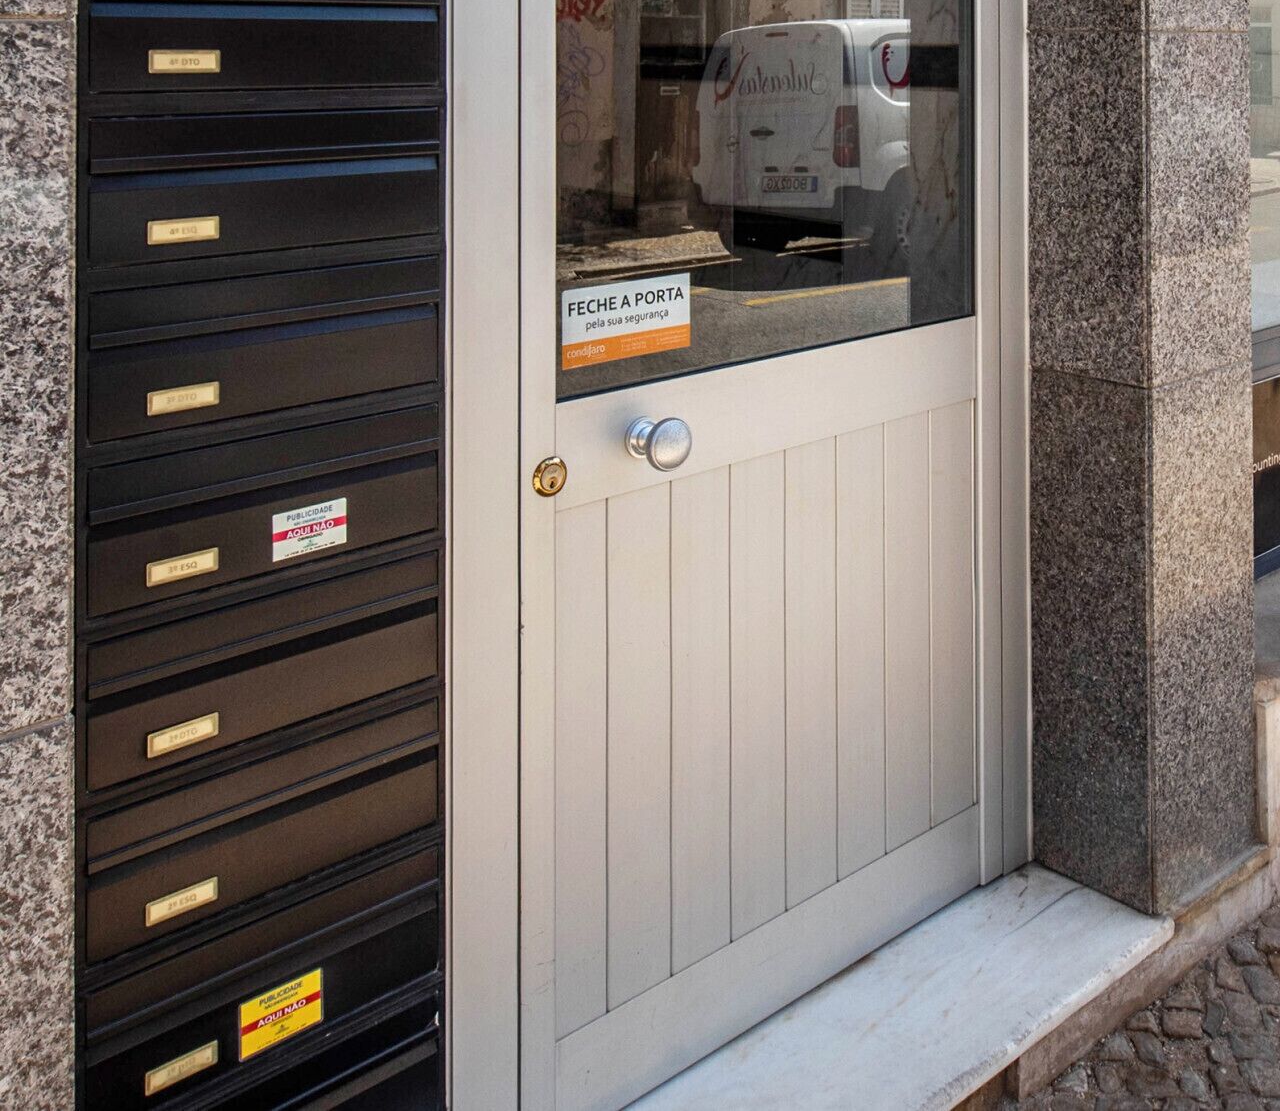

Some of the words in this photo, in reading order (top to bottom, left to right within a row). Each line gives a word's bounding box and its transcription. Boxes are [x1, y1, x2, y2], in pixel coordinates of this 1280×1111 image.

[182, 58, 200, 66] DTO
[568, 296, 617, 317] FECHE
[620, 294, 631, 309] A
[635, 286, 684, 306] PORTA
[585, 318, 605, 332] pela
[607, 316, 623, 327] sua
[624, 309, 669, 325] segurança
[287, 504, 333, 522] PUBLICIDADE
[286, 527, 311, 539] AQUI
[313, 519, 334, 534] NÃO
[180, 561, 198, 571] ESQ
[179, 893, 197, 905] ESQ
[259, 980, 302, 1006] PUBLICIDADE
[256, 1010, 283, 1028] AQUI
[284, 999, 306, 1014] NÃO
